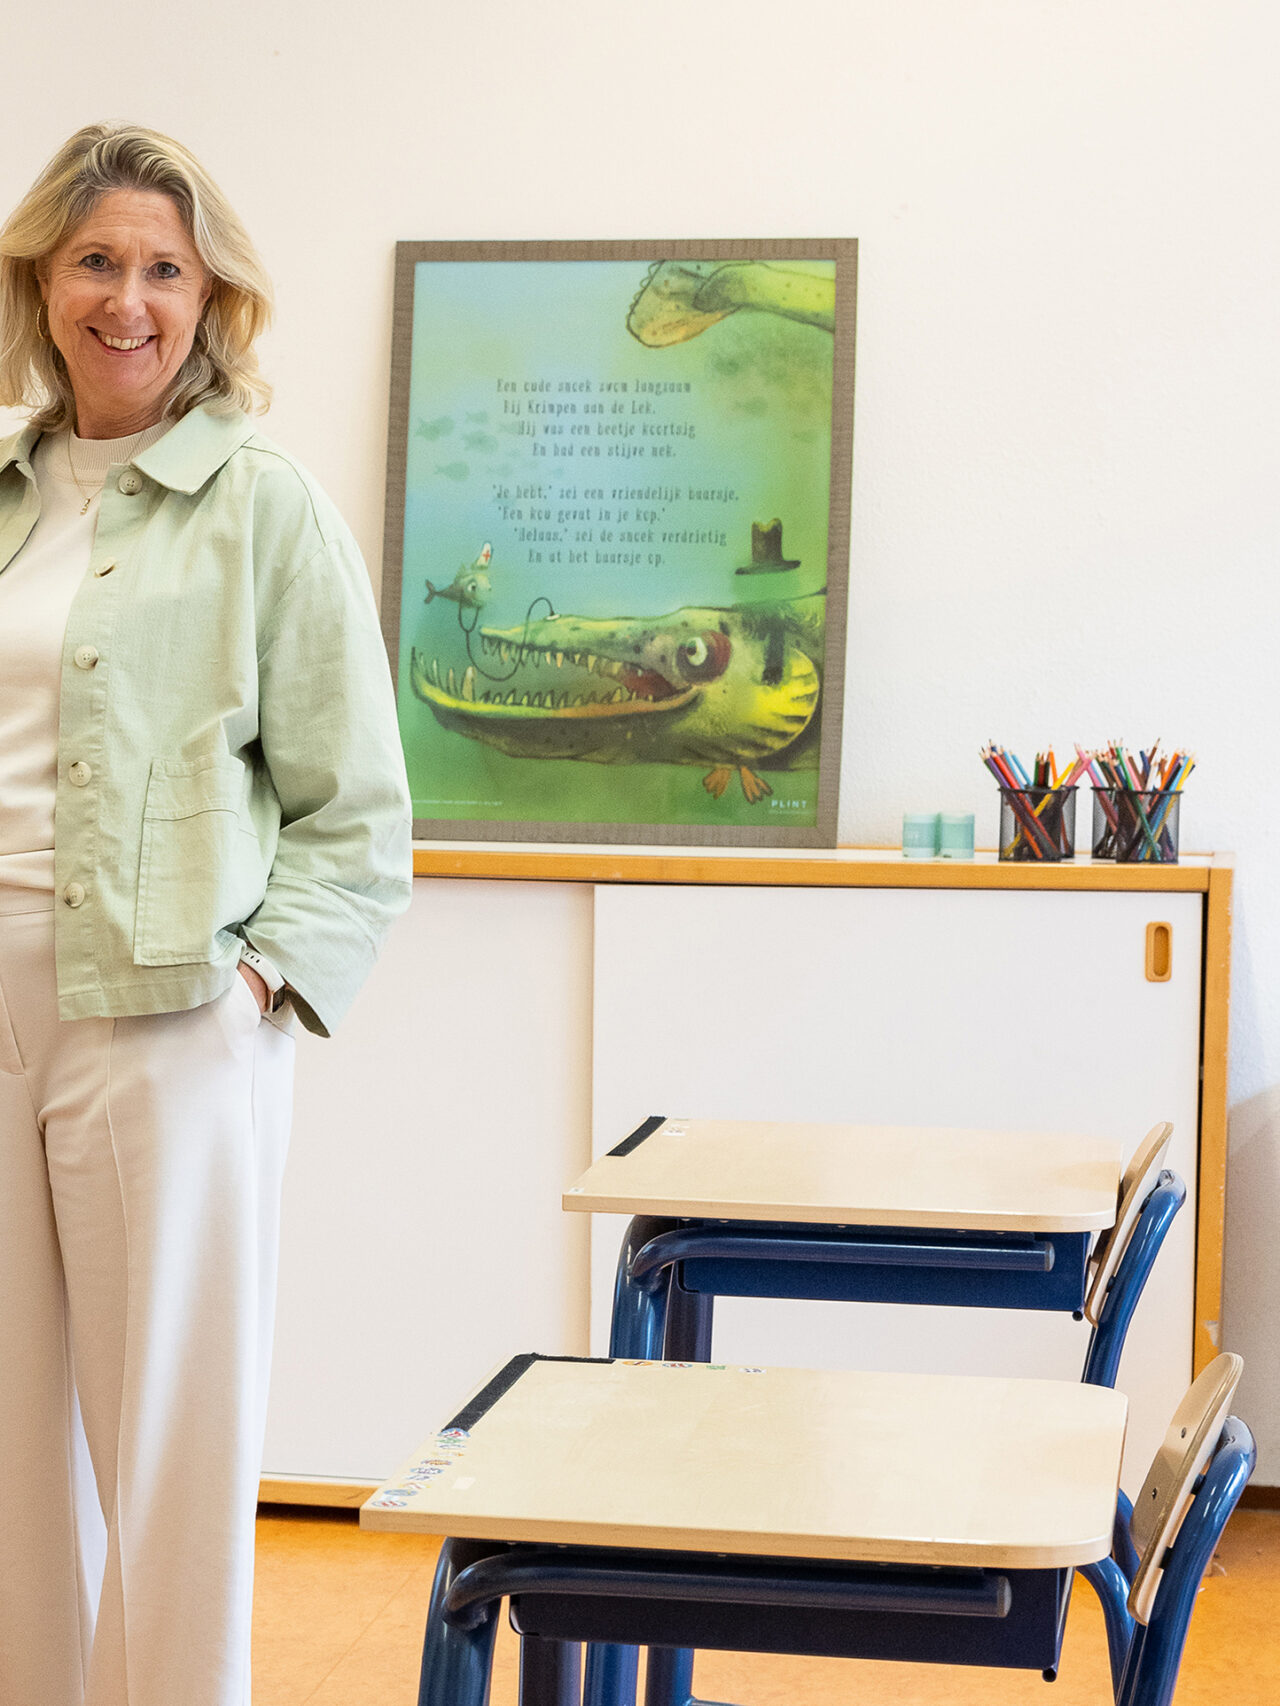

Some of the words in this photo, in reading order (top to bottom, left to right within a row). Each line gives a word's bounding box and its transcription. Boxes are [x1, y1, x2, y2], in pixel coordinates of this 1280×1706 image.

[496, 378, 517, 393] Een
[503, 399, 521, 416] Bij
[527, 399, 577, 417] Krimpen
[583, 403, 604, 414] aan
[611, 400, 624, 414] de
[631, 399, 656, 415] Lek.
[543, 424, 564, 435] was
[570, 424, 590, 435] een
[597, 421, 635, 438] beetje
[642, 421, 697, 439] koortsig
[532, 442, 546, 457] En
[553, 443, 574, 457] had
[580, 446, 601, 457] een
[607, 442, 645, 459] stijve
[651, 444, 677, 457] nek.
[560, 486, 576, 500] zei
[583, 488, 604, 499] een
[612, 486, 681, 503] vriendelijk
[558, 507, 591, 523] gevat
[598, 507, 611, 520] in
[617, 507, 629, 524] je
[575, 528, 592, 542] zei
[600, 529, 613, 542] de
[662, 528, 727, 546] verdrietig
[528, 548, 542, 563] En
[549, 551, 561, 563] at
[569, 549, 588, 563] het
[595, 550, 641, 566] baarsje
[771, 799, 808, 809] PLINT
